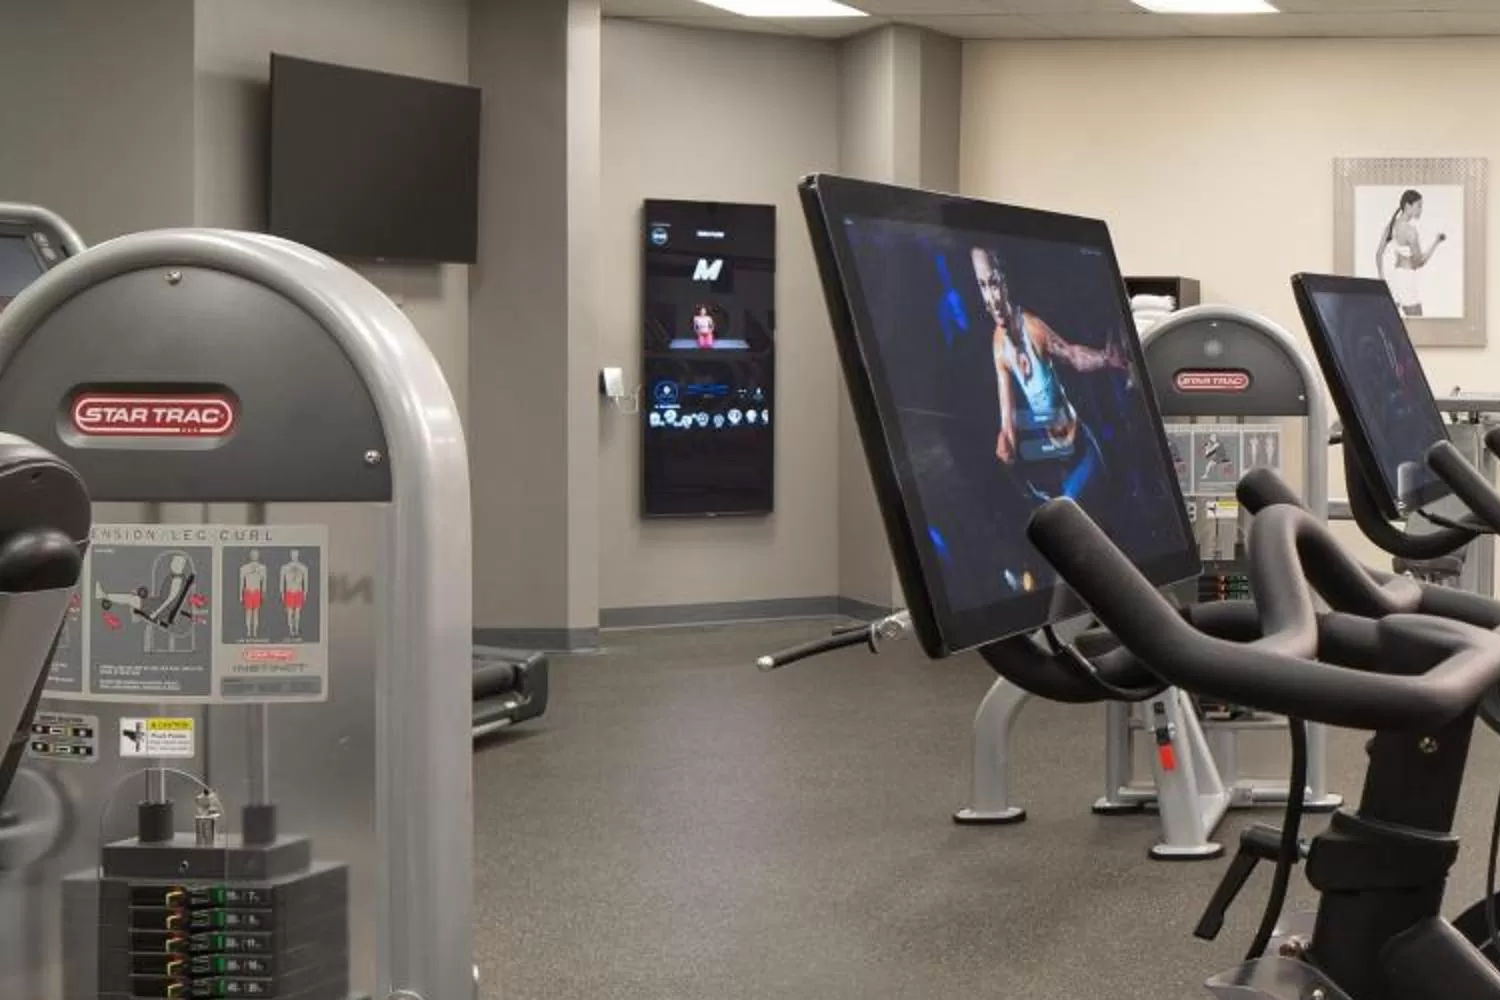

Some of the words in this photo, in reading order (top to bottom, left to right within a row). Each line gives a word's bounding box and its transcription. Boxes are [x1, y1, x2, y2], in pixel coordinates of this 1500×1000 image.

[84, 407, 148, 424] STAR
[152, 407, 220, 424] TRAC
[170, 529, 208, 541] LEG
[219, 529, 274, 542] CURL
